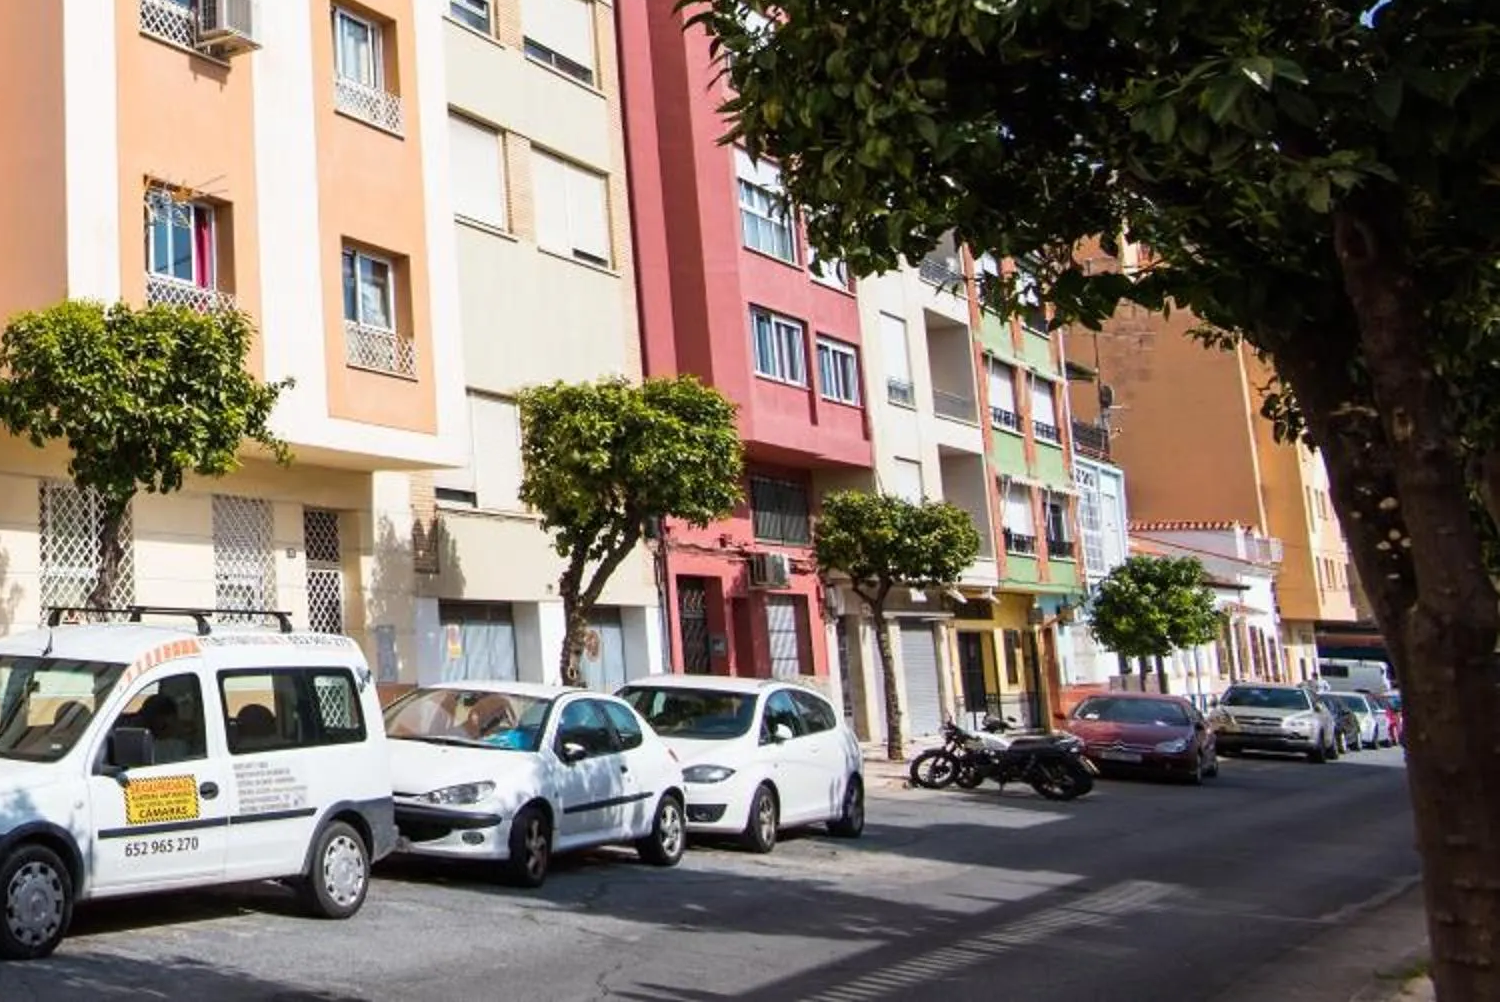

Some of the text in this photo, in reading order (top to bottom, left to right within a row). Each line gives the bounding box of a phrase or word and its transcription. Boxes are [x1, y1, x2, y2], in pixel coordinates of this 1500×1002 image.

[125, 836, 199, 857] 652 965 270
